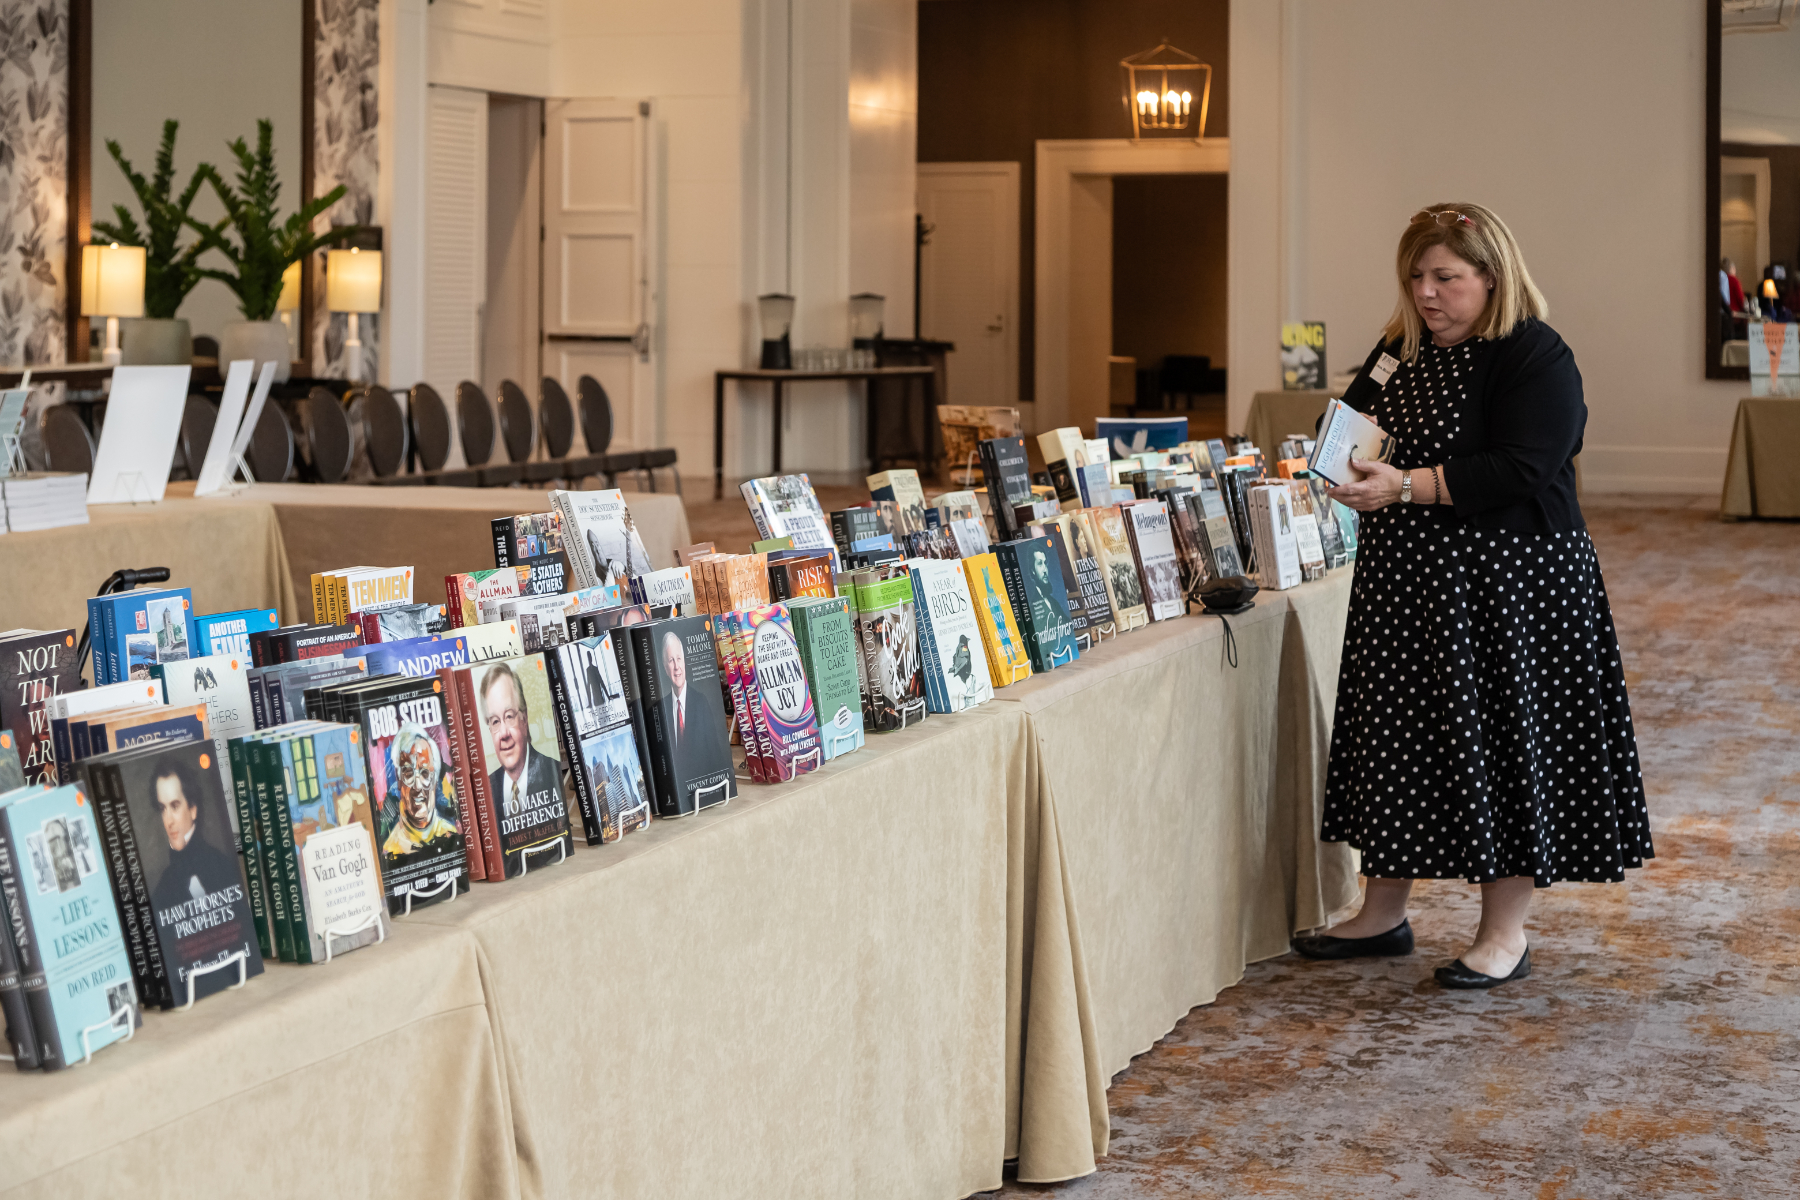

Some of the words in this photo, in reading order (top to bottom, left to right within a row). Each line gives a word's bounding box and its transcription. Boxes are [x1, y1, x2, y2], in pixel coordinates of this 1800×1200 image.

[1282, 324, 1324, 346] KING
[578, 505, 589, 513] DOC
[589, 503, 620, 512] SCHNEIDER
[563, 501, 571, 515] THE
[574, 530, 590, 570] SCHNEIDER
[790, 515, 816, 530] PROUD
[497, 535, 507, 555] THE
[537, 563, 564, 579] STATLER
[797, 566, 825, 588] RISE
[1077, 573, 1087, 584] THE
[1087, 570, 1102, 582] LORD
[1078, 556, 1098, 572] THANK
[352, 579, 377, 606] TEN
[377, 575, 409, 603] MEN
[480, 585, 513, 598] ALLMAN
[938, 578, 952, 591] YEAR
[1003, 568, 1016, 601] RESTLESS
[1012, 602, 1021, 622] FIRES
[1013, 568, 1026, 601] RESTLESS
[1022, 602, 1031, 622] FIRES
[1083, 584, 1094, 596] AM
[1094, 581, 1106, 593] NOT
[931, 588, 968, 618] BIRDS
[984, 594, 1006, 609] COMING
[1084, 598, 1091, 609] A
[1090, 593, 1109, 607] YANKEE
[209, 618, 248, 638] ANOTHER
[822, 618, 842, 634] FROM
[882, 598, 910, 658] Cook
[992, 611, 1005, 624] INTO
[297, 636, 319, 648] PORTRAIT
[319, 635, 327, 644] OF
[327, 635, 333, 643] AN
[333, 632, 358, 642] AMERICAN
[298, 640, 359, 660] BUSINESSMAN
[686, 633, 709, 644] TOMMY
[686, 641, 712, 655] MALONE
[718, 621, 727, 646] CONNELL
[725, 651, 735, 675] LYNSKEY
[732, 621, 742, 646] CONNELL
[741, 653, 751, 676] LYNSKEY
[758, 645, 766, 653] THE
[766, 642, 775, 652] BEAT
[776, 640, 787, 650] WITH
[762, 631, 778, 643] KEEPING
[818, 629, 848, 648] BISCUITS
[861, 620, 875, 660] COOK
[17, 643, 62, 675] NOT
[398, 648, 465, 678] ANDREW
[757, 653, 771, 664] DUANE
[771, 652, 780, 660] AND
[780, 647, 793, 659] GREGG
[820, 647, 832, 660] TO
[833, 643, 849, 657] LANE
[827, 657, 847, 672] CAKE
[923, 652, 934, 677] BIRDS
[95, 650, 103, 681] Letters
[110, 651, 118, 682] Letters
[616, 637, 625, 667] TOMMY
[621, 668, 631, 701] MALONE
[641, 637, 651, 667] TOMMY
[646, 668, 656, 701] MALONE
[759, 657, 803, 691] ALLMAN
[868, 661, 878, 674] &
[932, 652, 943, 678] BIRDS
[399, 692, 411, 700] BEST
[412, 690, 419, 698] OF
[777, 686, 797, 711] JOY
[870, 675, 884, 710] TELL
[368, 704, 400, 740] BOB
[399, 695, 442, 730] STEED
[447, 708, 454, 726] TO
[463, 709, 473, 729] TO
[580, 720, 598, 732] URBAN
[598, 710, 627, 726] STATESMAN
[589, 707, 600, 718] THE
[730, 683, 752, 733] ALLMAN
[743, 734, 758, 757] JOY
[745, 684, 767, 734] ALLMAN
[758, 735, 775, 758] JOY
[448, 729, 460, 762] MAKE
[467, 731, 479, 764] MAKE
[783, 733, 792, 744] BILL
[792, 728, 809, 741] CONNELL
[788, 743, 798, 754] JOHN
[798, 737, 816, 750] LYNSKEY
[554, 682, 564, 701] THE
[559, 702, 569, 721] CEO
[565, 730, 578, 764] URBAN
[573, 764, 592, 818] STATESMAN
[454, 765, 462, 773] A
[473, 767, 481, 775] A
[687, 780, 708, 791] VINCENT
[237, 780, 253, 844] READING
[257, 782, 274, 846] READING
[455, 775, 475, 850] DIFFERENCE
[503, 800, 519, 816] TO
[521, 790, 549, 811] MAKE
[552, 787, 560, 801] A
[274, 784, 291, 848] READING
[475, 779, 494, 853] DIFFERENCE
[502, 802, 565, 835] DIFFERENCE
[315, 839, 361, 861] READING
[509, 832, 527, 847] JAMES
[246, 848, 258, 876] VAN
[267, 850, 279, 879] VAN
[285, 853, 296, 880] VAN
[312, 864, 337, 882] Van
[339, 853, 368, 877] Gogh
[101, 800, 131, 902] HAWTHORNE'S
[123, 903, 149, 977] PROPHETS
[115, 802, 147, 904] HAWTHORNE'S
[140, 906, 165, 979] PROPHETS
[414, 877, 428, 890] STEED
[60, 896, 92, 926] LIFE
[159, 884, 243, 927] HAWTHORNE'S
[251, 880, 263, 917] GOGH
[271, 882, 285, 920] GOGH
[289, 885, 302, 922] GOGH
[361, 904, 373, 914] Cox
[174, 904, 236, 939] PROPHETS
[53, 921, 110, 959] LESSONS
[66, 976, 91, 998] DON
[91, 963, 116, 988] REID
